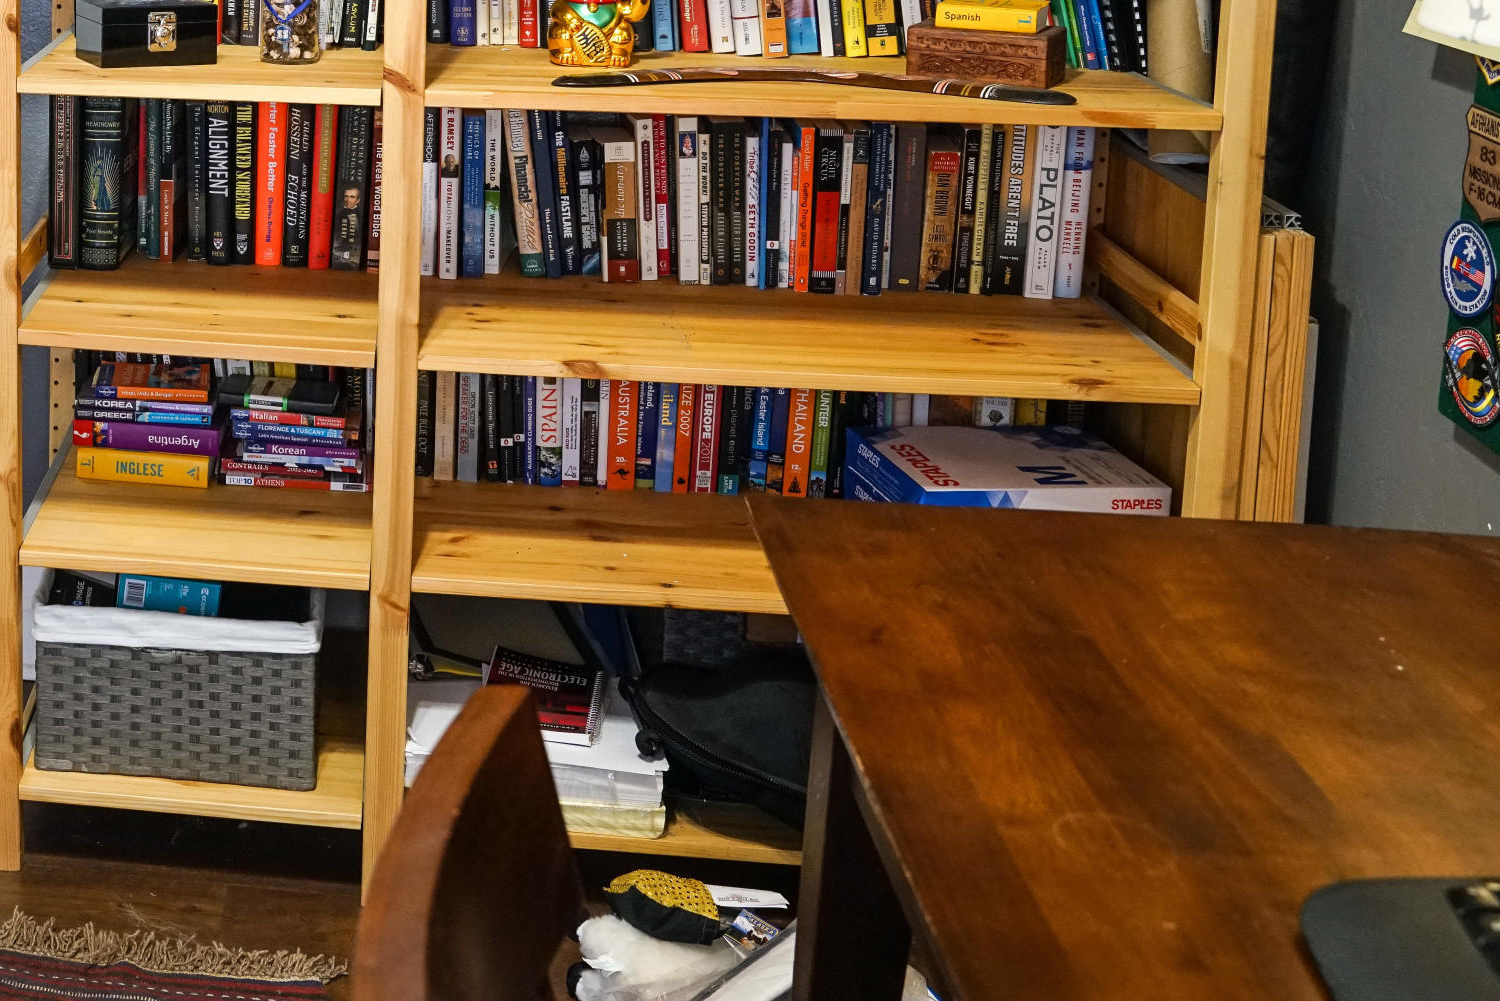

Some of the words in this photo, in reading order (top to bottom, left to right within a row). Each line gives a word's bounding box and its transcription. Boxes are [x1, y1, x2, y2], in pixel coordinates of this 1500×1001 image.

[943, 11, 982, 24] Spanish
[207, 105, 229, 113] NORTON
[237, 105, 252, 125] THE
[236, 127, 252, 169] BALANCED
[268, 127, 278, 159] Faster
[290, 108, 301, 161] HOSSEINI
[555, 131, 563, 146] the
[209, 117, 229, 198] ALIGNMENT
[555, 147, 567, 194] Millionaire
[821, 148, 830, 181] CIRCUS
[828, 150, 837, 179] NIGHT
[1480, 146, 1497, 167] 83
[267, 161, 277, 192] Better
[235, 171, 251, 220] SCORECARD
[287, 174, 300, 227] ECHOED
[1008, 178, 1023, 217] AREN'T
[1036, 166, 1058, 243] PLATO
[299, 189, 308, 240] MOUNTAINS
[560, 196, 572, 238] FASTLANE
[748, 204, 756, 229] SETH
[748, 231, 756, 262] GODIN
[1004, 219, 1019, 248] FREE
[1062, 221, 1072, 255] MANKELL
[1073, 221, 1082, 256] HENNING
[94, 399, 134, 410] KOREA
[94, 411, 133, 420] GREECE
[252, 411, 278, 420] Italian
[541, 388, 558, 444] SPAIN
[617, 380, 630, 446] AUSTRALIA
[702, 393, 713, 440] EUROPE
[760, 394, 769, 420] Easter
[679, 410, 690, 437] 2007
[757, 422, 765, 447] Island
[792, 388, 809, 454] THAILAND
[149, 435, 200, 451] Argentina
[272, 444, 306, 456] Korean
[701, 442, 711, 464] 2011
[858, 443, 881, 468] STAPLES
[116, 461, 164, 478] INGLESE
[227, 463, 269, 471] CONTRAILS
[890, 443, 960, 488] STAPLES
[1111, 498, 1163, 511] STAPLES
[500, 660, 521, 676] AGE
[522, 664, 587, 686] ELECTRONIC
